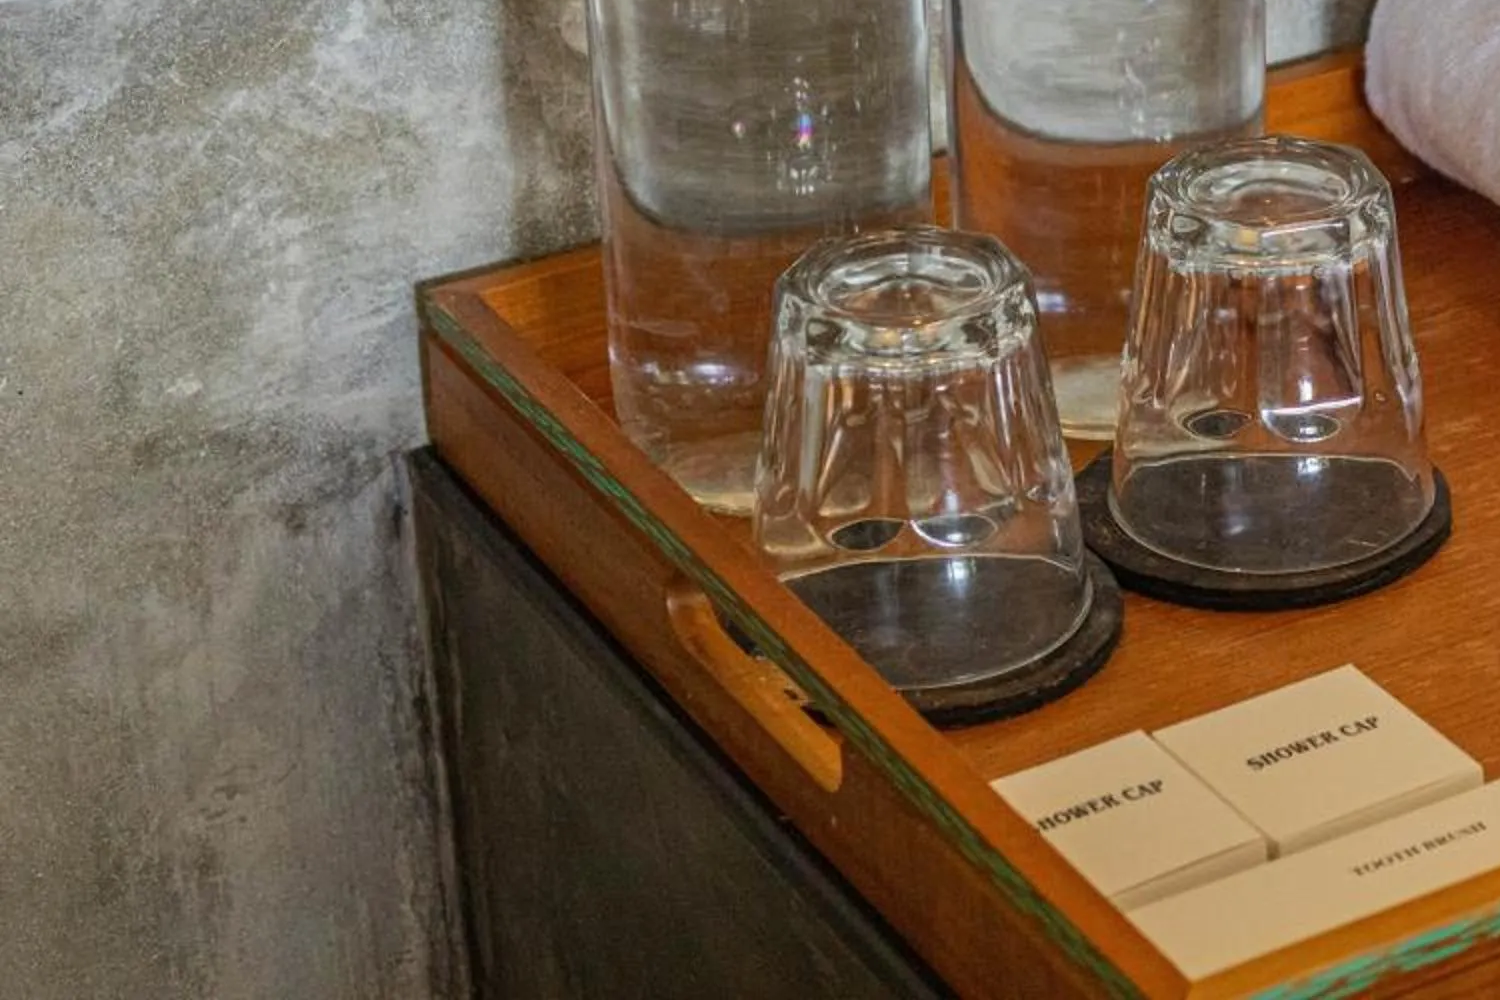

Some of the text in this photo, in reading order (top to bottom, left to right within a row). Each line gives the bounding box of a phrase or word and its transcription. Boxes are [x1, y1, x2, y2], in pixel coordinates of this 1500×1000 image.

[1246, 716, 1379, 771] SHOWER CAP
[1036, 779, 1163, 832] HOWER CAP
[1350, 821, 1486, 876] TOOTH BRUSH
